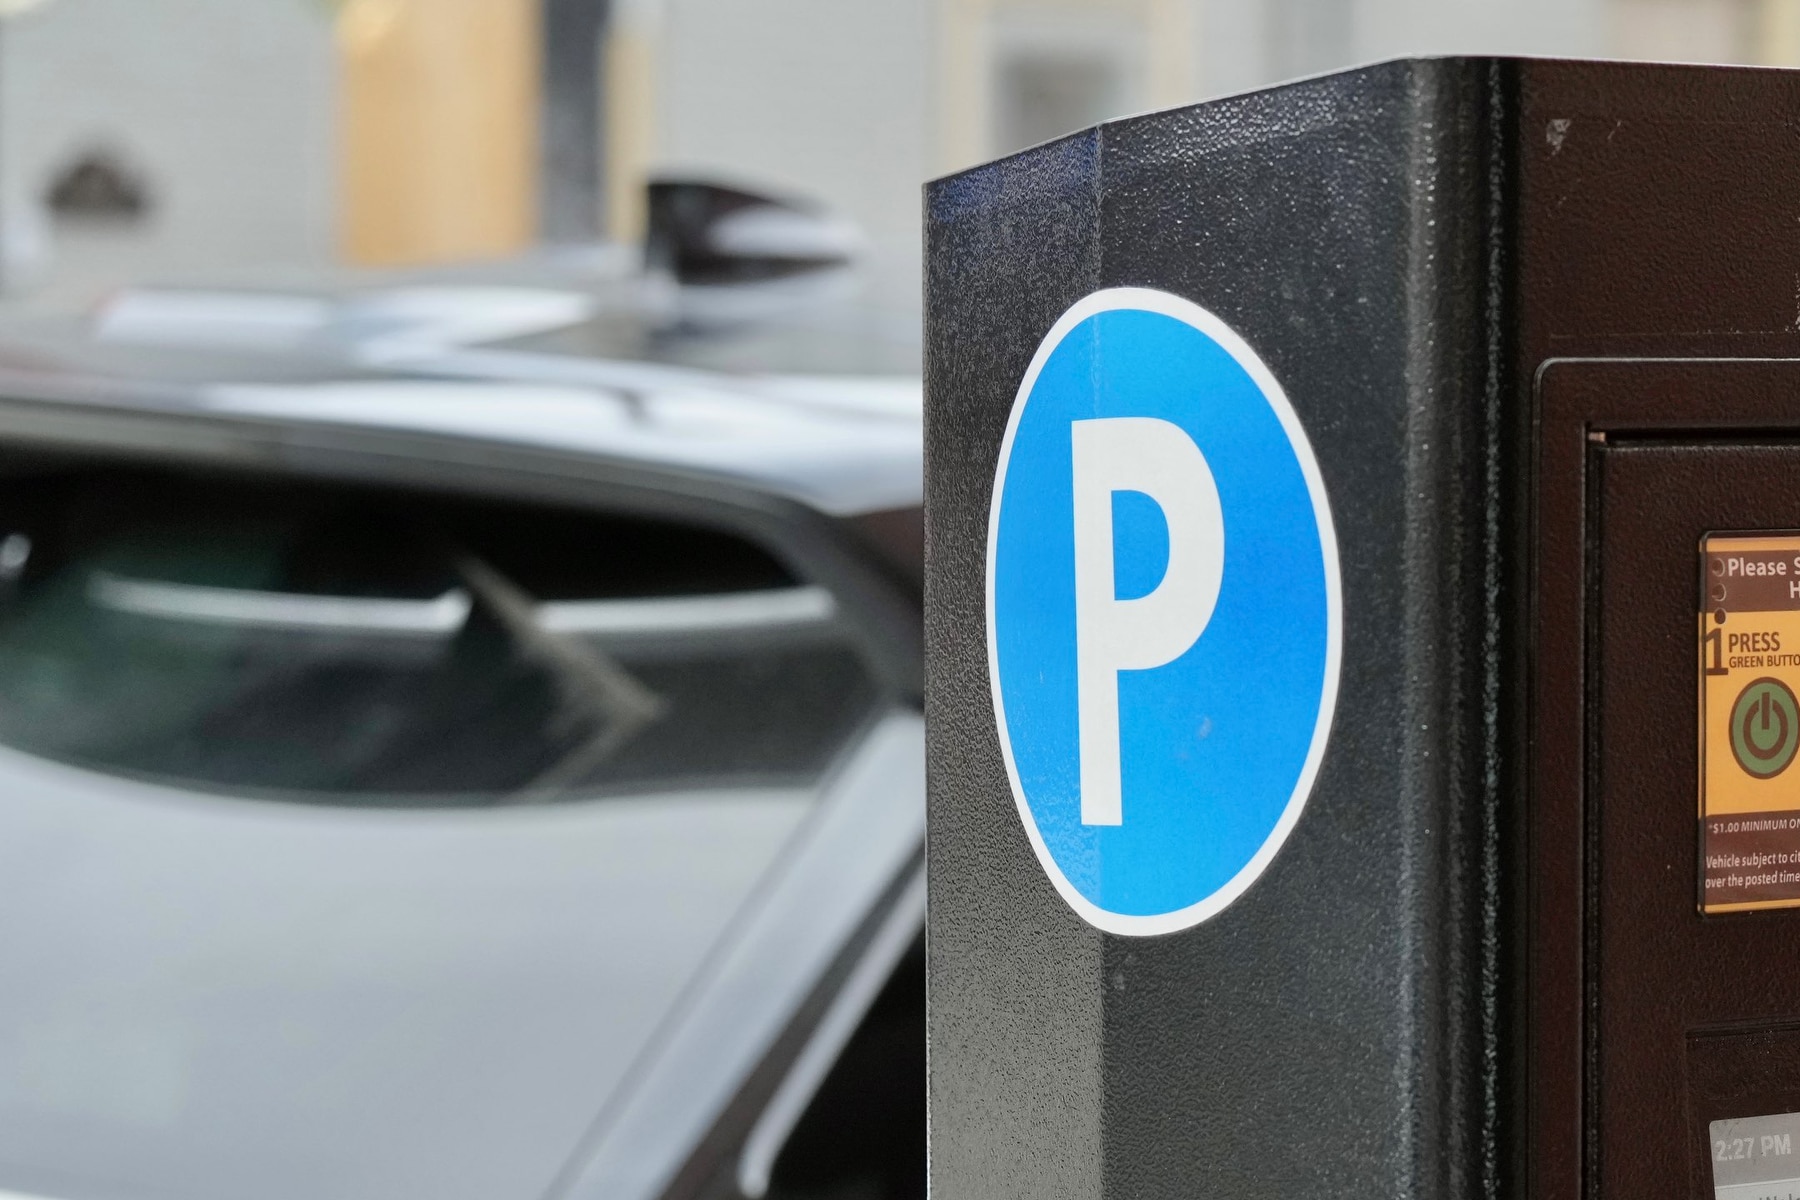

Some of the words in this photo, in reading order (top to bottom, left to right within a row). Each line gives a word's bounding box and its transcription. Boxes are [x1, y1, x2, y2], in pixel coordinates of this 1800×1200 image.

[1727, 557, 1787, 577] Please
[1072, 416, 1225, 826] P
[1704, 627, 1728, 675] 1
[1728, 631, 1780, 653] PRESS
[1729, 655, 1764, 669] GREEN
[1741, 819, 1787, 832] MINIMUM
[1706, 853, 1740, 869] Vehicle
[1742, 851, 1776, 869] subject
[1778, 852, 1788, 864] to
[1705, 878, 1725, 889] over
[1728, 874, 1743, 887] the
[1745, 871, 1778, 889] posted
[1779, 870, 1800, 884] time
[1761, 1133, 1792, 1158] PM
